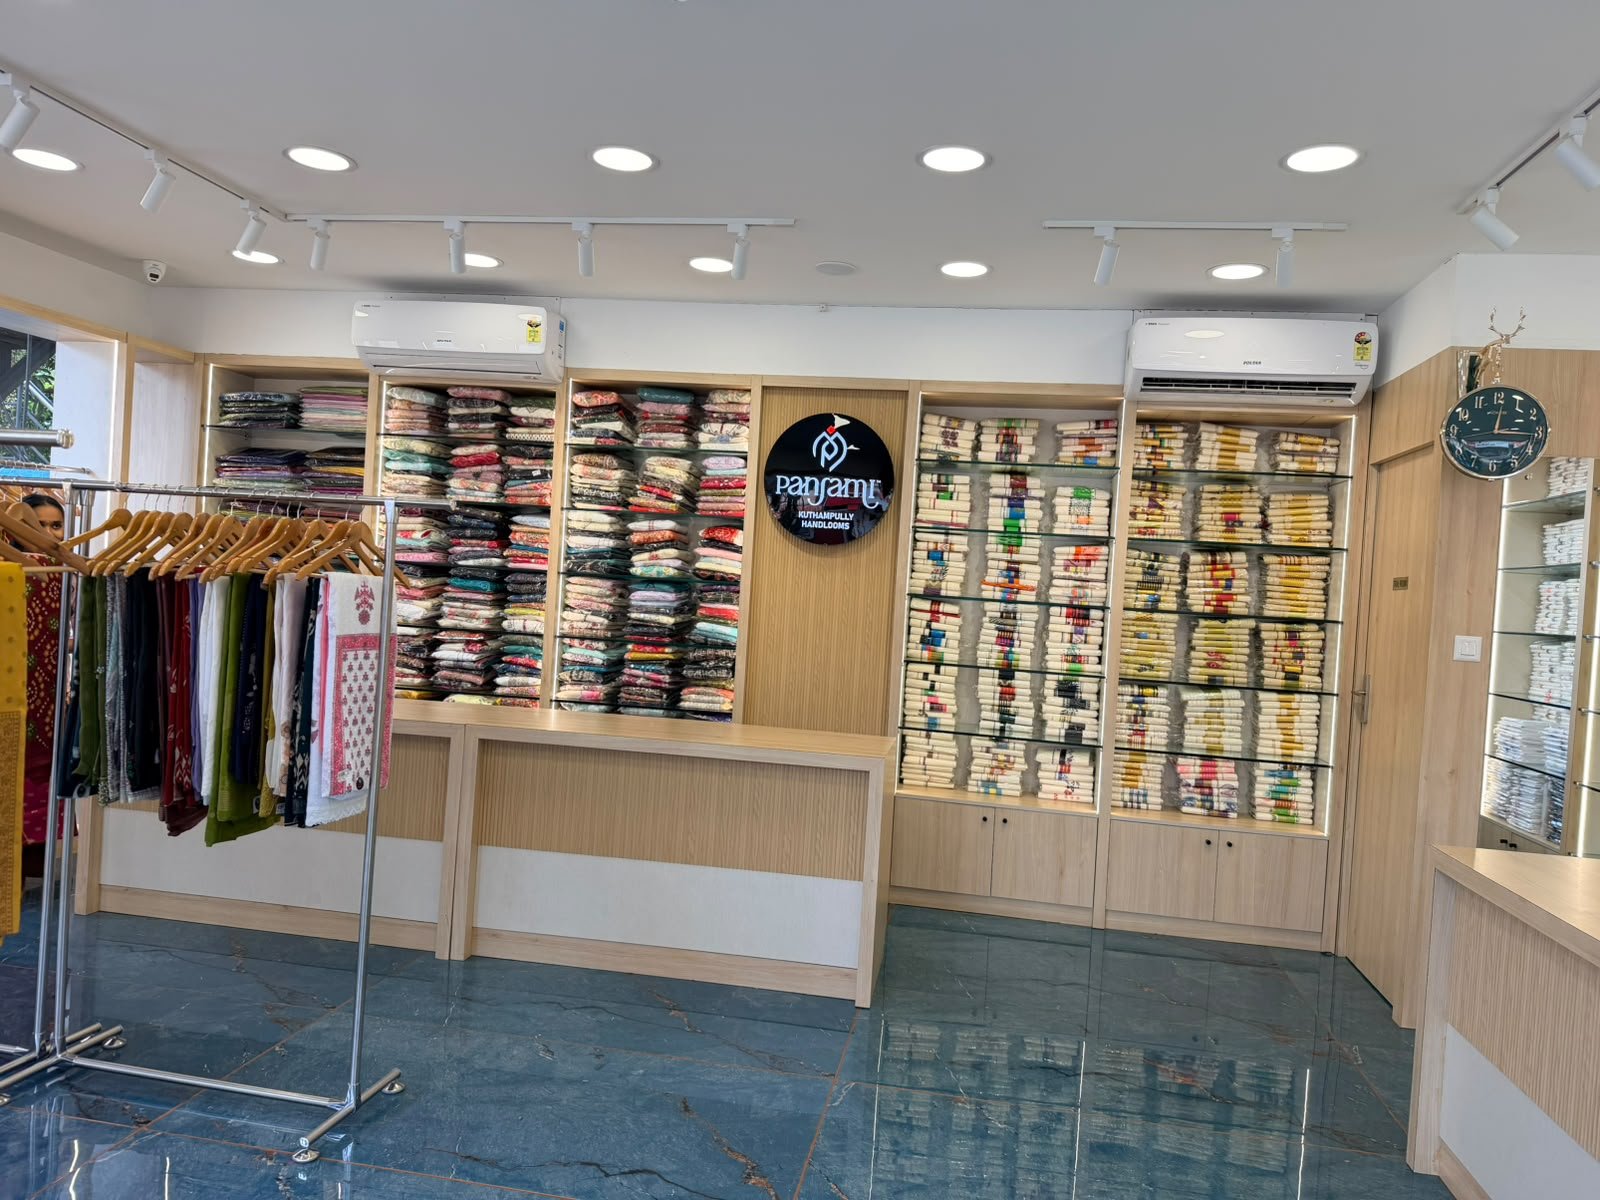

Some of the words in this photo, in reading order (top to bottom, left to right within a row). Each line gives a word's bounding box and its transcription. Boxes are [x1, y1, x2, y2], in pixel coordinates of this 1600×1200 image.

[1493, 392, 1504, 404] 12
[1530, 408, 1536, 420] 2
[1450, 424, 1457, 438] 9
[1536, 426, 1542, 438] 3
[1456, 444, 1463, 456] 8
[1526, 442, 1532, 456] 4
[1470, 455, 1477, 467] 7
[1488, 460, 1496, 472] 6
[1510, 455, 1518, 468] 5
[798, 510, 854, 520] KUTHAMPULLY
[802, 520, 850, 530] HANDLOOMS
